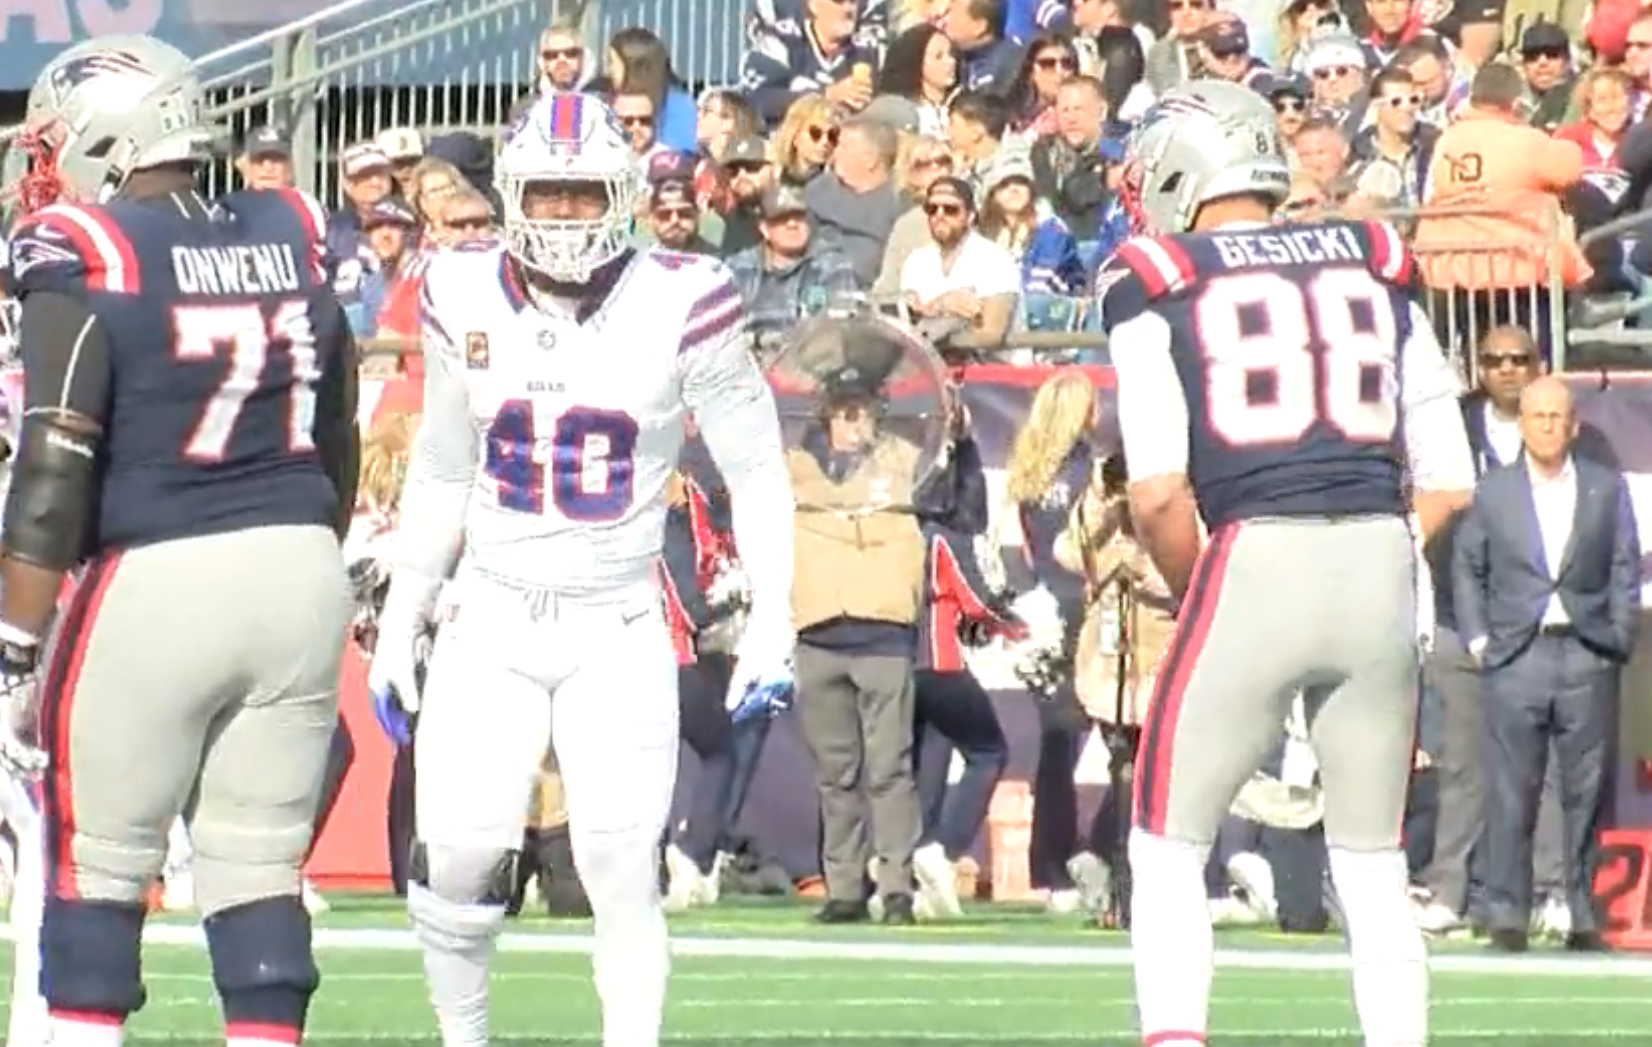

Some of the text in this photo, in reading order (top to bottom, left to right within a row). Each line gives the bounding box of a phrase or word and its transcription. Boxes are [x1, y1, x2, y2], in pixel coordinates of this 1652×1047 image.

[171, 243, 299, 293] ONWENU
[1211, 226, 1364, 269] GESICKI
[171, 300, 321, 465] 71
[1195, 270, 1400, 450] 88
[484, 398, 639, 523] 40
